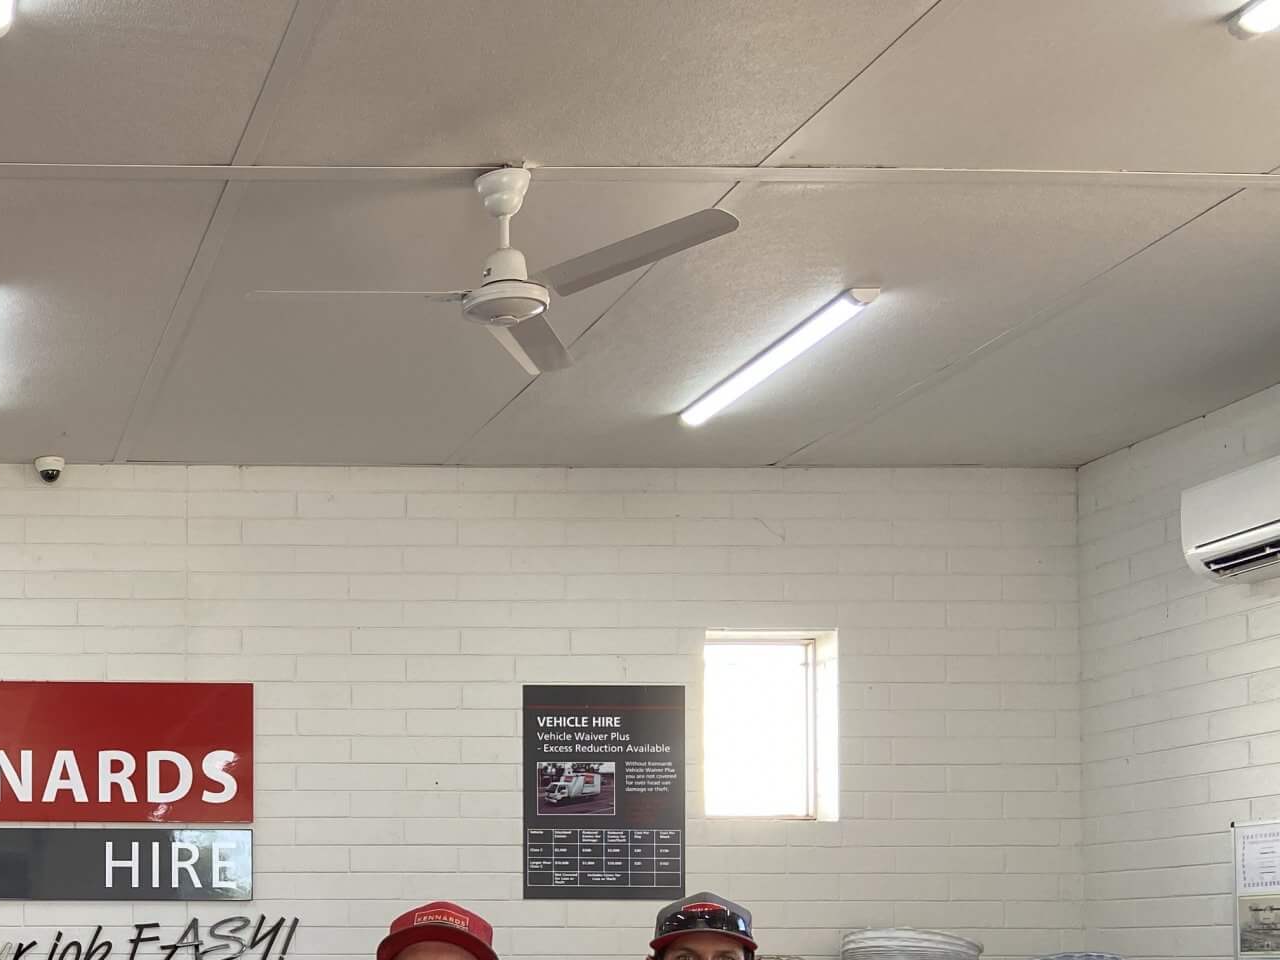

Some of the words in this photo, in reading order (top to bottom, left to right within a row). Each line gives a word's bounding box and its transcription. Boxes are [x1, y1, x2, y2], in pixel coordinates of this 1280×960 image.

[537, 716, 589, 728] VEHICLE
[593, 717, 621, 727] HIRE
[537, 732, 572, 741] Vehicle
[574, 732, 608, 741] Waiver
[611, 733, 630, 741] Plus
[543, 744, 573, 753] Excess
[575, 744, 623, 753] Reduction
[626, 744, 671, 753] Available
[104, 840, 237, 889] HIRE
